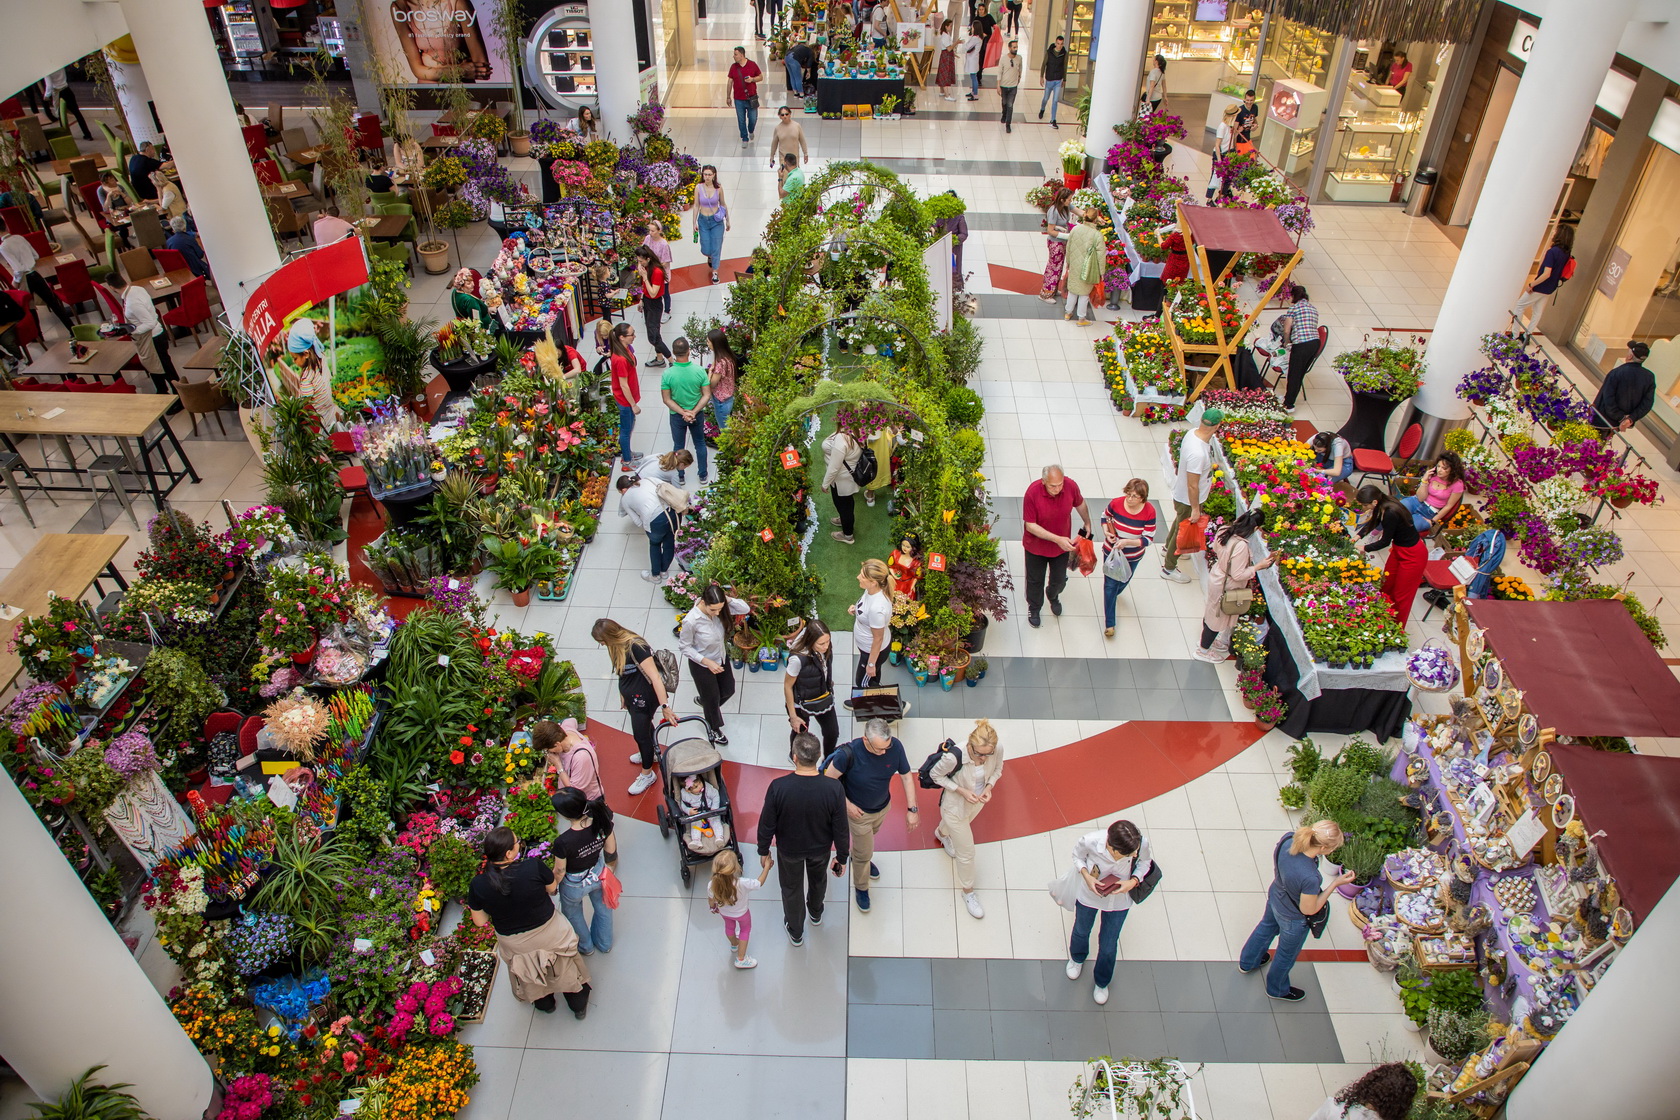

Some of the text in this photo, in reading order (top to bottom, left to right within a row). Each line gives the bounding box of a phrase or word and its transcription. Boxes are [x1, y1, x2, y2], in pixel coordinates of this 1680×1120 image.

[392, 7, 477, 27] brosway
[1522, 34, 1535, 52] C
[251, 298, 269, 324] CENTRI
